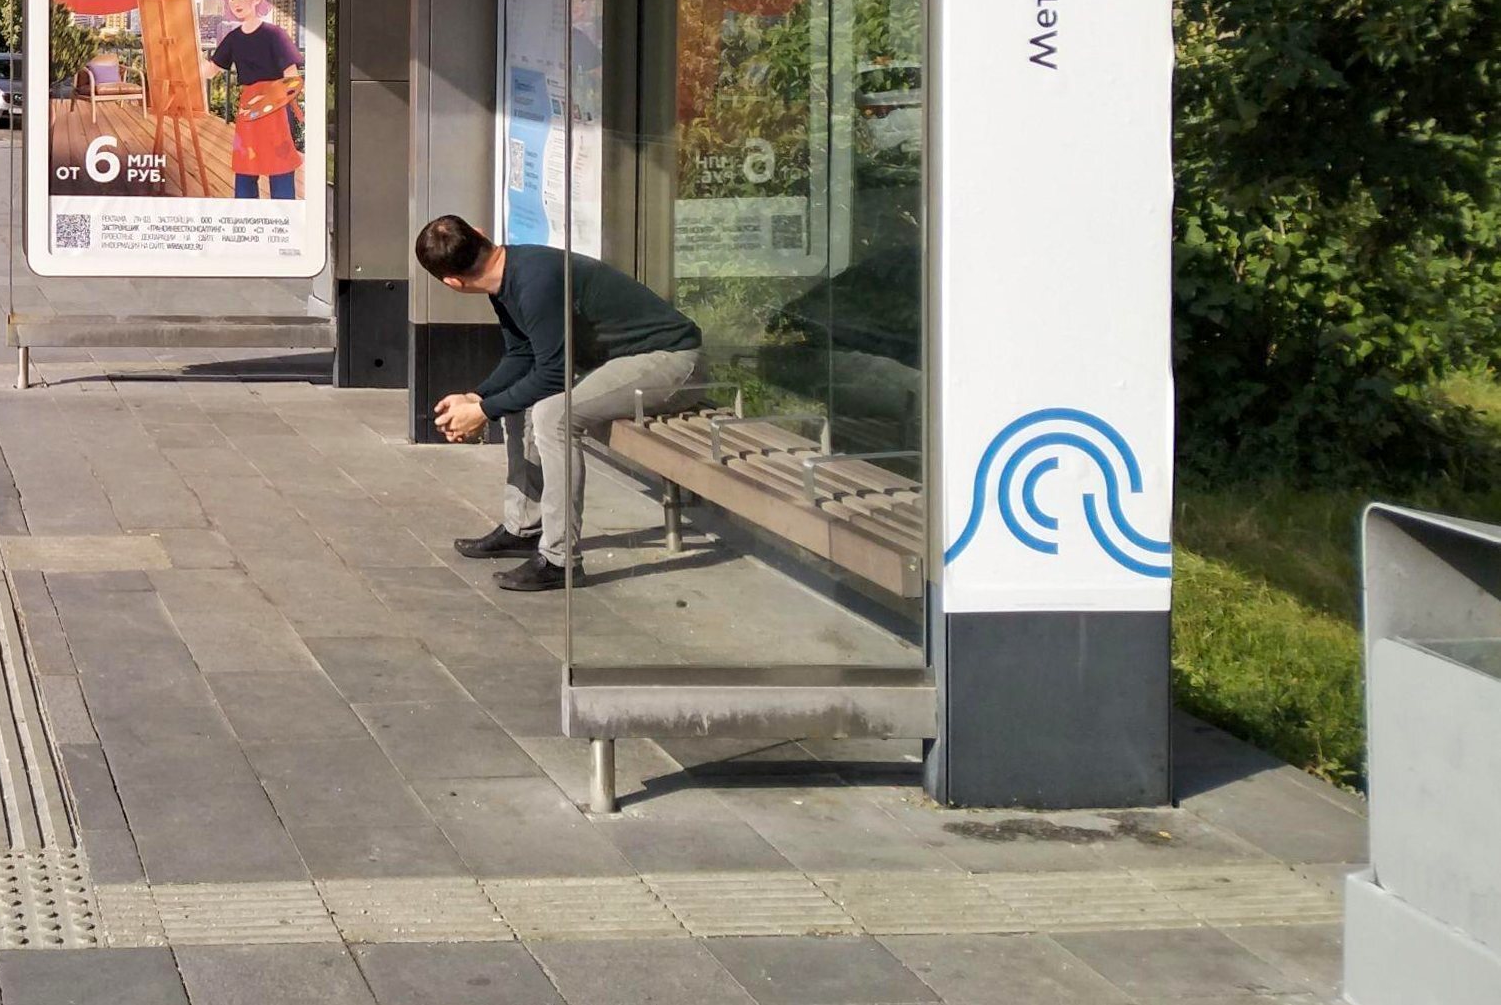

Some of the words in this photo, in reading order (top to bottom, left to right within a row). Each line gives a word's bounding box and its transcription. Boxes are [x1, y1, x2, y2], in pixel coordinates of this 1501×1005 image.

[55, 166, 81, 180] ОТ
[85, 135, 121, 183] 6
[127, 154, 166, 168] МЛН
[127, 169, 166, 183] РУБ.
